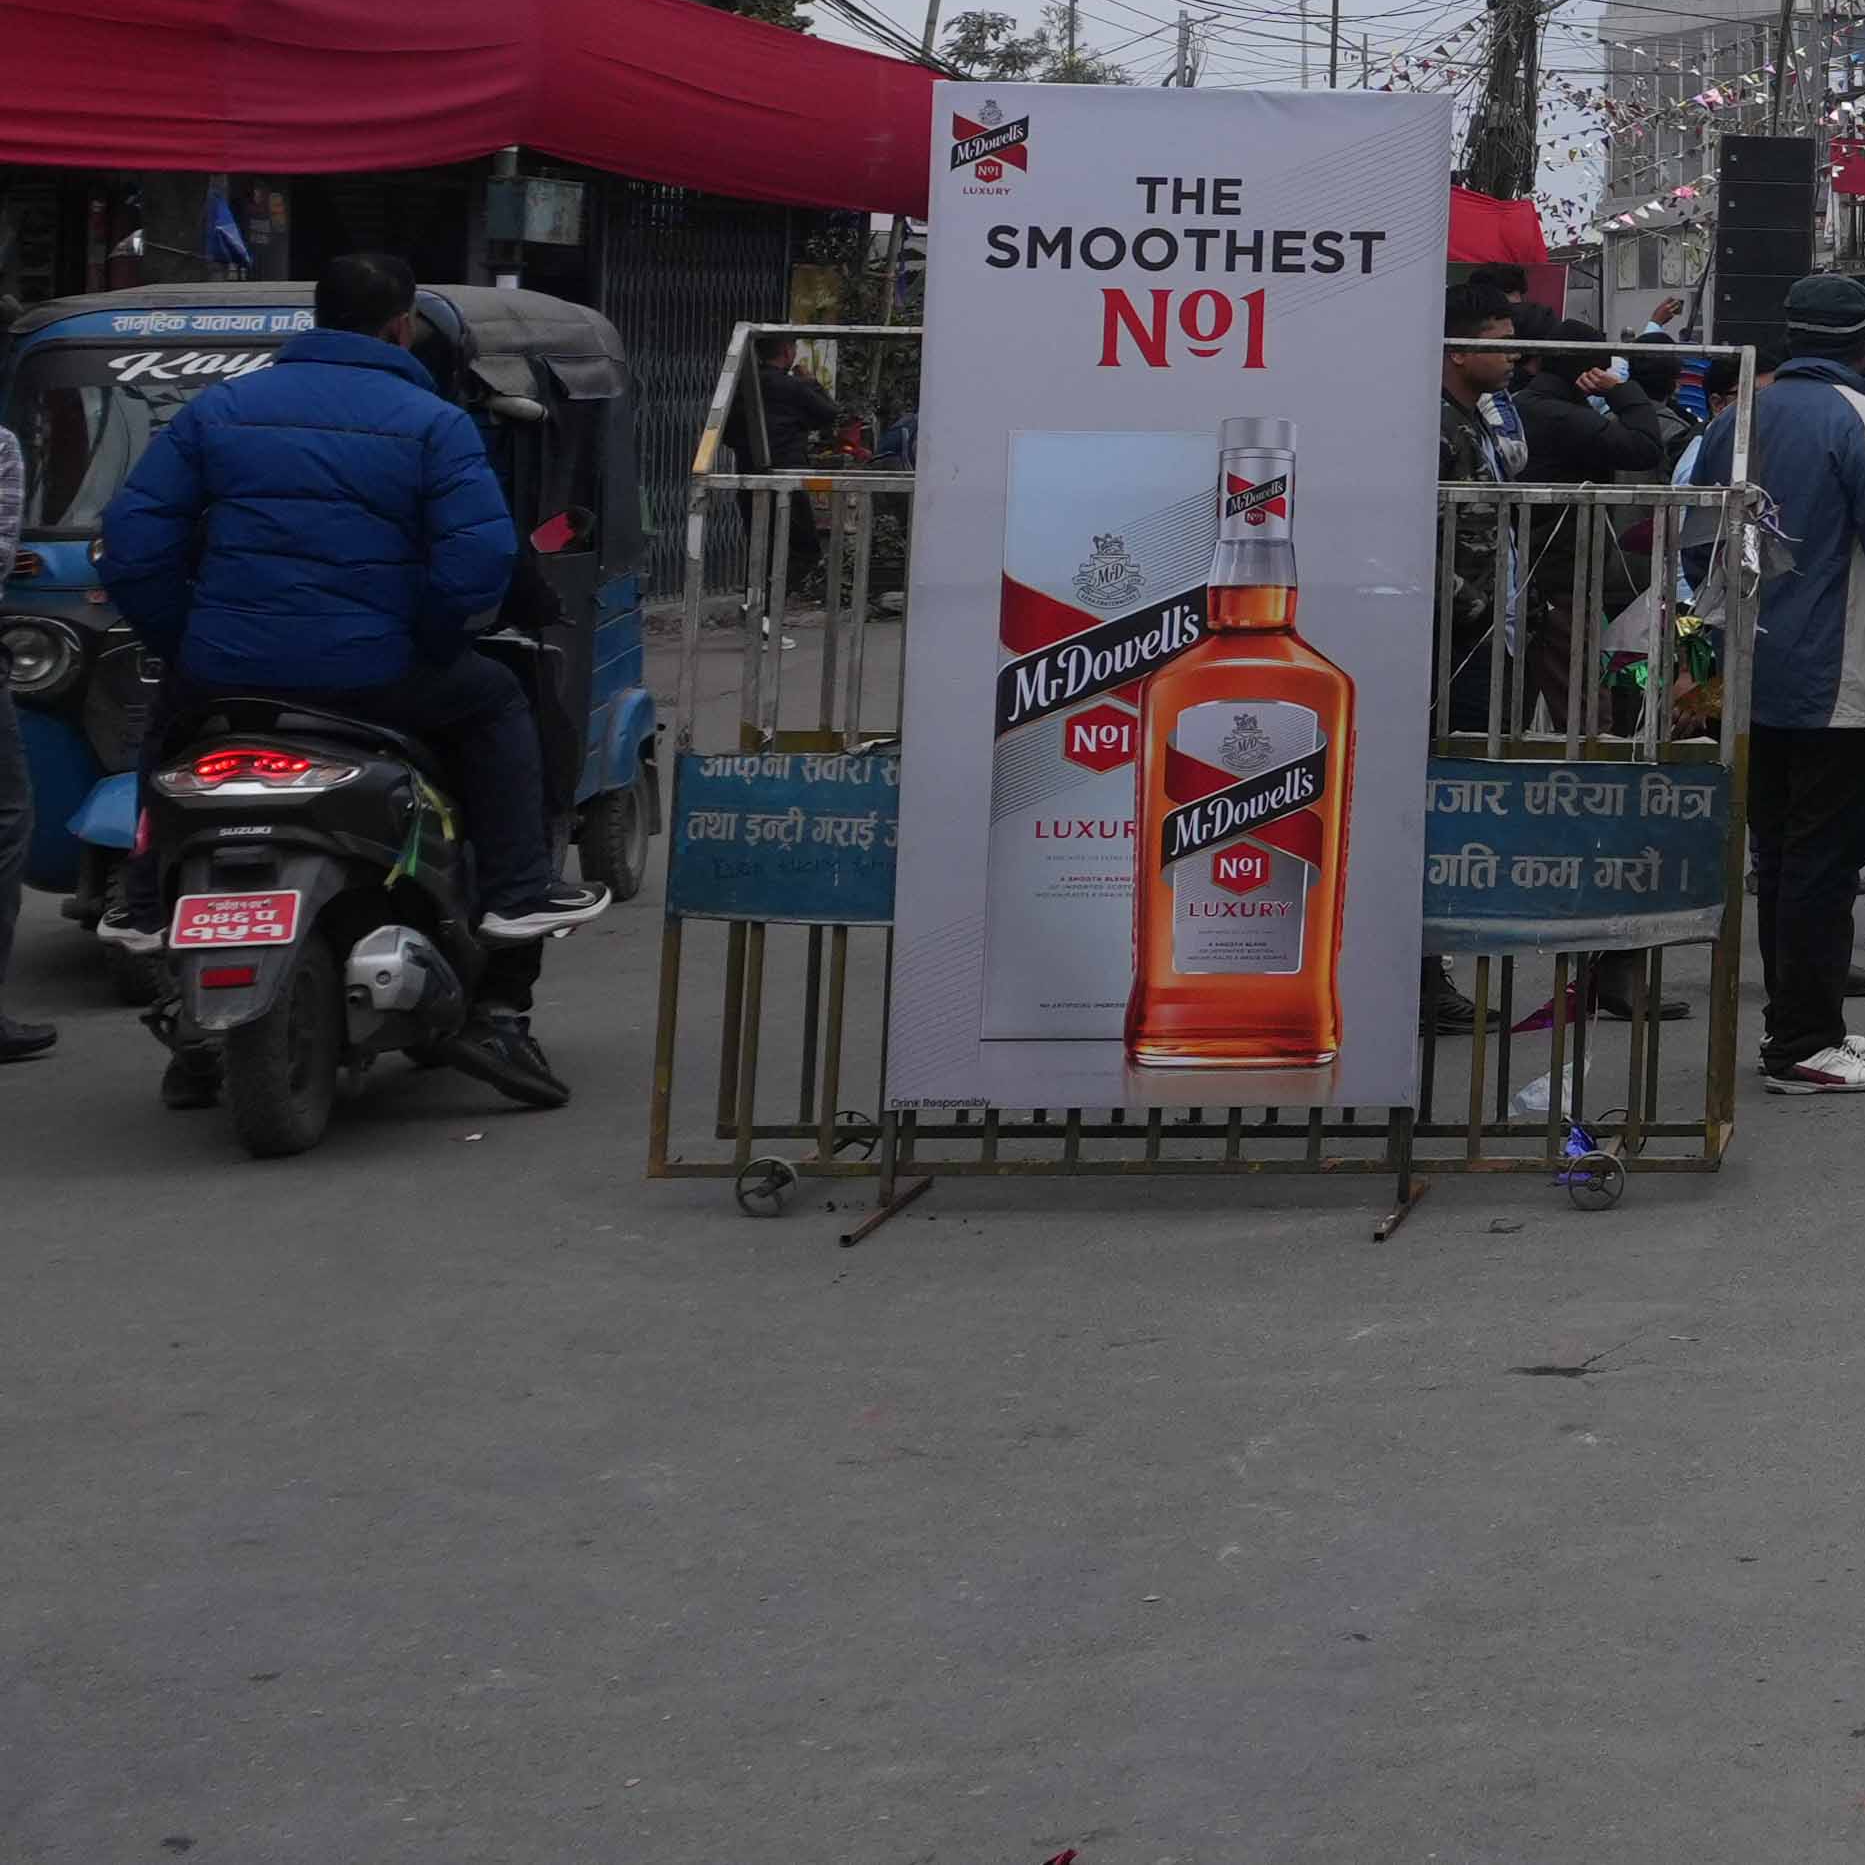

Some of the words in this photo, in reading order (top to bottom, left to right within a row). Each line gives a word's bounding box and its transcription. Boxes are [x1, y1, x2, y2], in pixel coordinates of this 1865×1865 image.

[962, 186, 1012, 195] LUXURY
[1136, 177, 1243, 216] THE
[985, 225, 1386, 274] SMOOTHEST
[112, 311, 188, 335] सामूहिक
[191, 314, 267, 332] यातायात
[1523, 770, 1630, 817] एरिया
[1640, 772, 1717, 820] भित्र
[219, 825, 272, 837] SUZUKI
[687, 811, 739, 841] तथा
[811, 809, 880, 852] गराई
[1429, 842, 1501, 889] गति
[1511, 856, 1583, 889] कम
[1188, 901, 1294, 918] LUXURY
